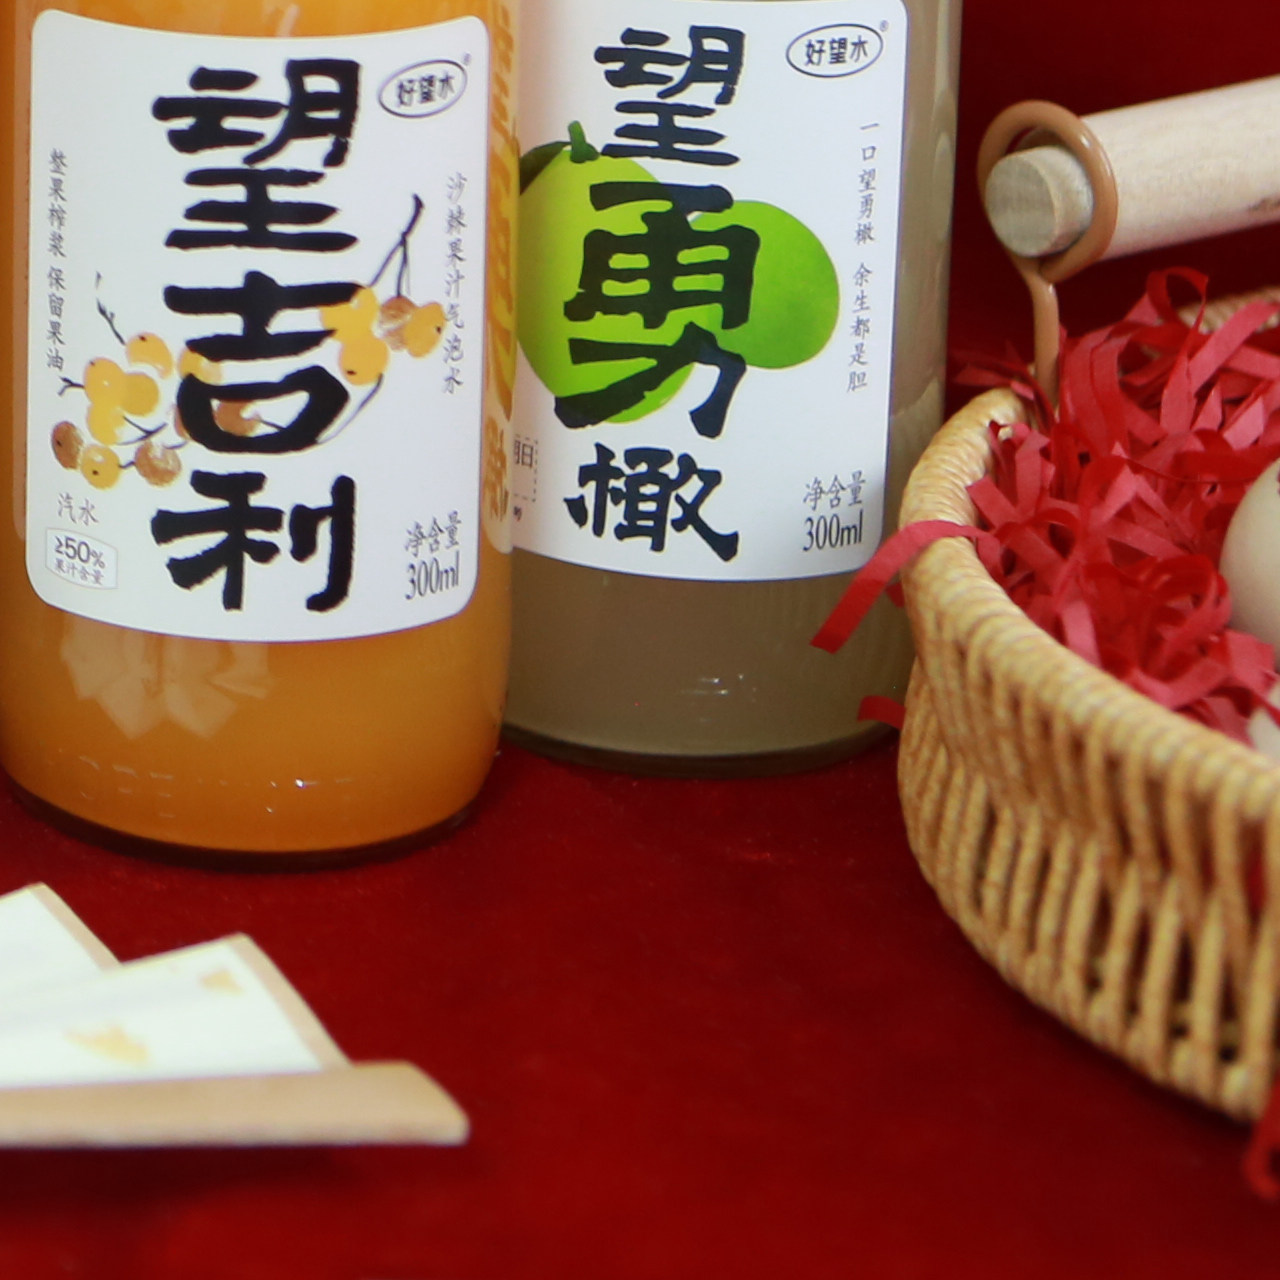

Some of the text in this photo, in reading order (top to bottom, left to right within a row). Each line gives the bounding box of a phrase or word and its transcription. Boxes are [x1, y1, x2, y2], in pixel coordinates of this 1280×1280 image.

[804, 37, 869, 66] 好望水
[396, 73, 457, 108] 好望水
[554, 25, 760, 561] 望勇橄
[150, 57, 362, 613] 望吉利
[58, 492, 99, 526] 汽水
[802, 474, 866, 508] 净含量
[405, 513, 461, 558] 净含量
[802, 507, 864, 552] 300ml
[405, 557, 460, 601] 300ml
